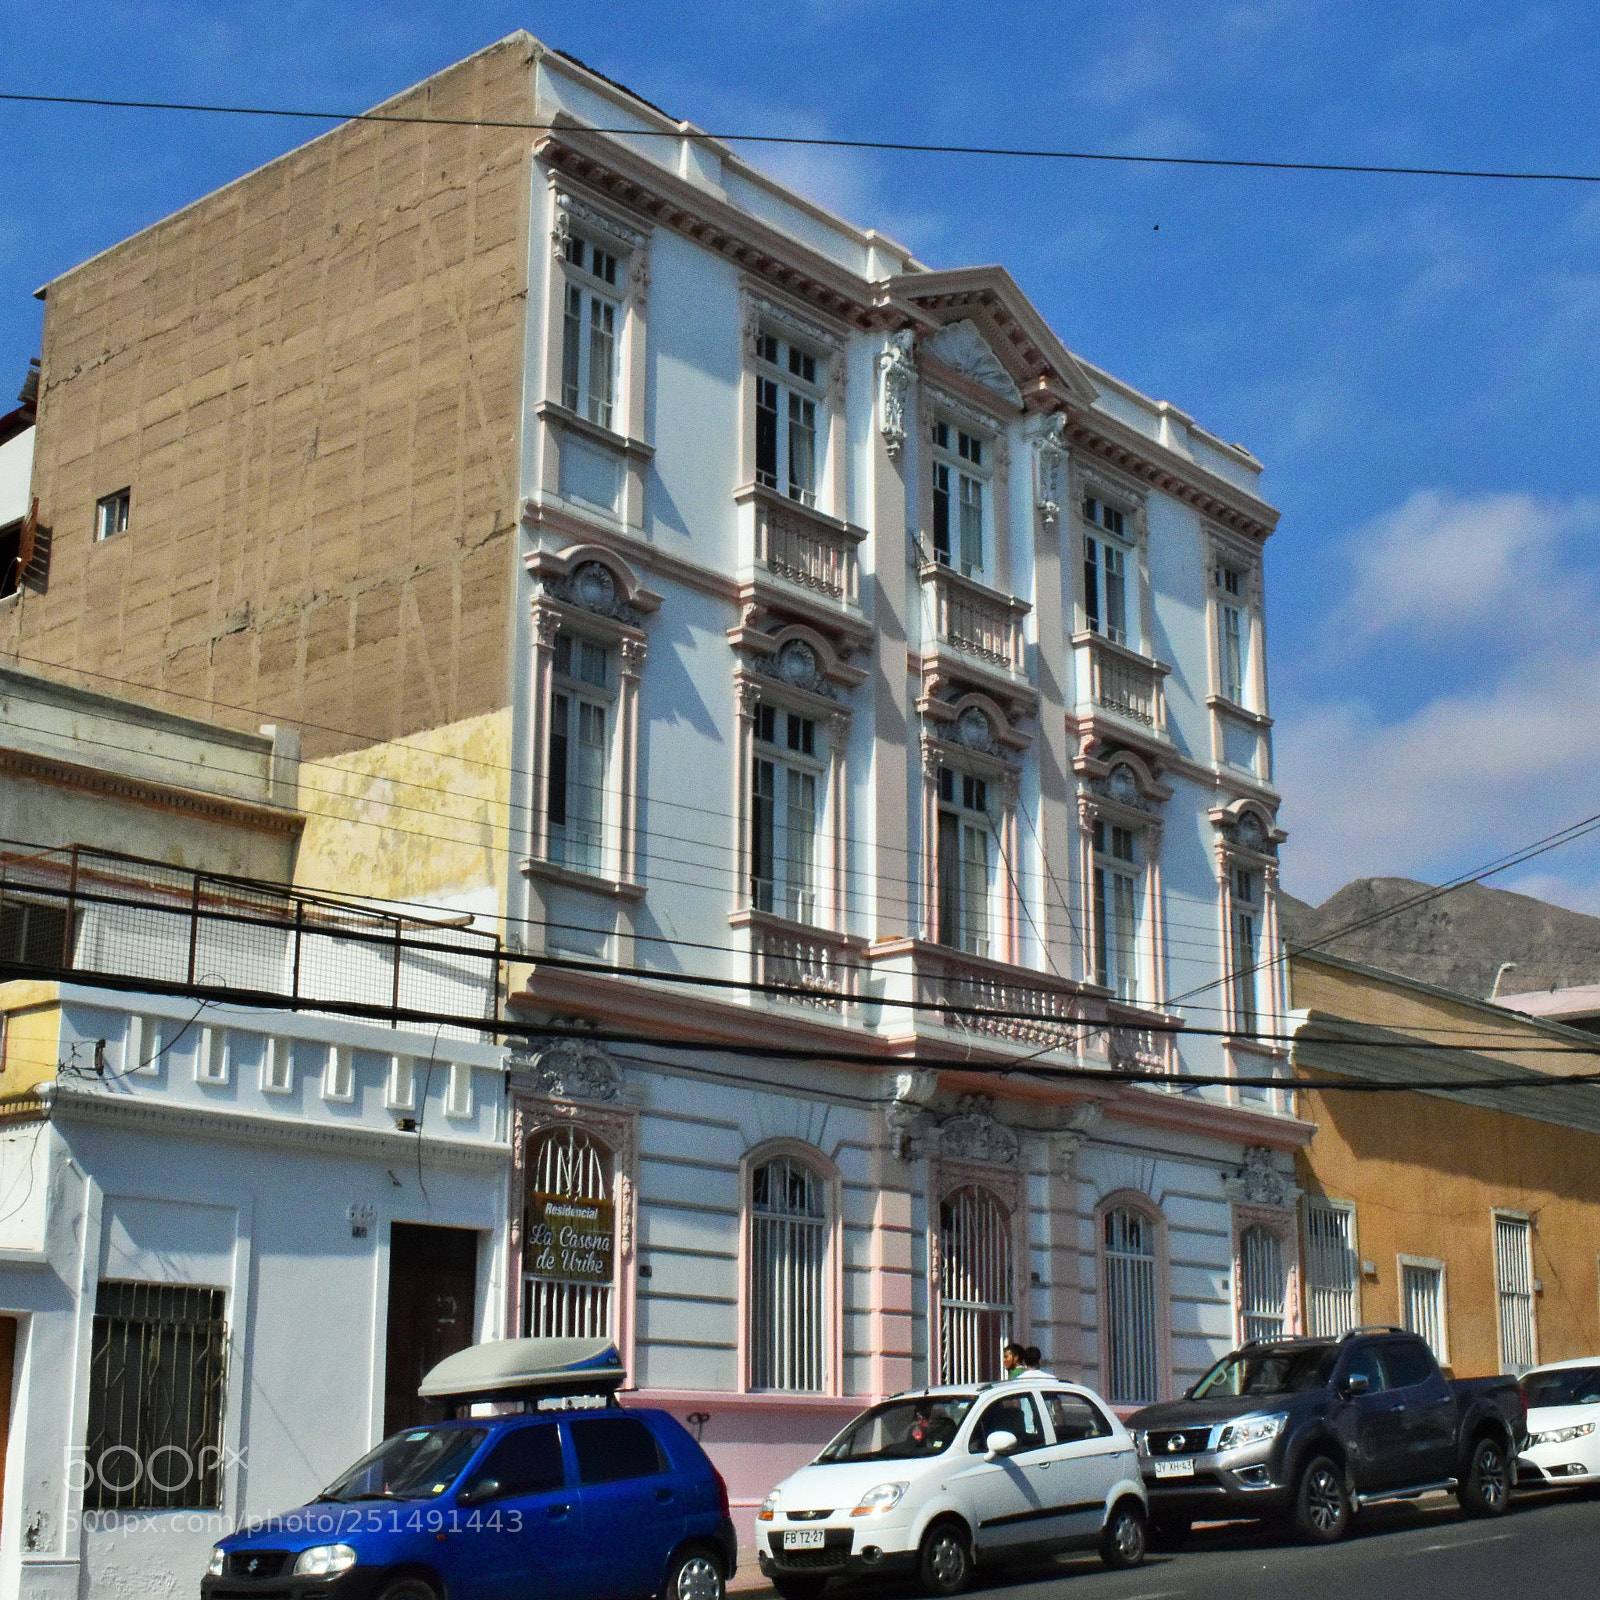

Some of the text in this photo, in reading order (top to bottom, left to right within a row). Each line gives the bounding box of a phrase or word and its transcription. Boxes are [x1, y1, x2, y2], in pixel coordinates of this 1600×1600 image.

[545, 1202, 598, 1220] Residencial
[529, 1223, 610, 1251] La Casona
[536, 1248, 604, 1274] de Uribe
